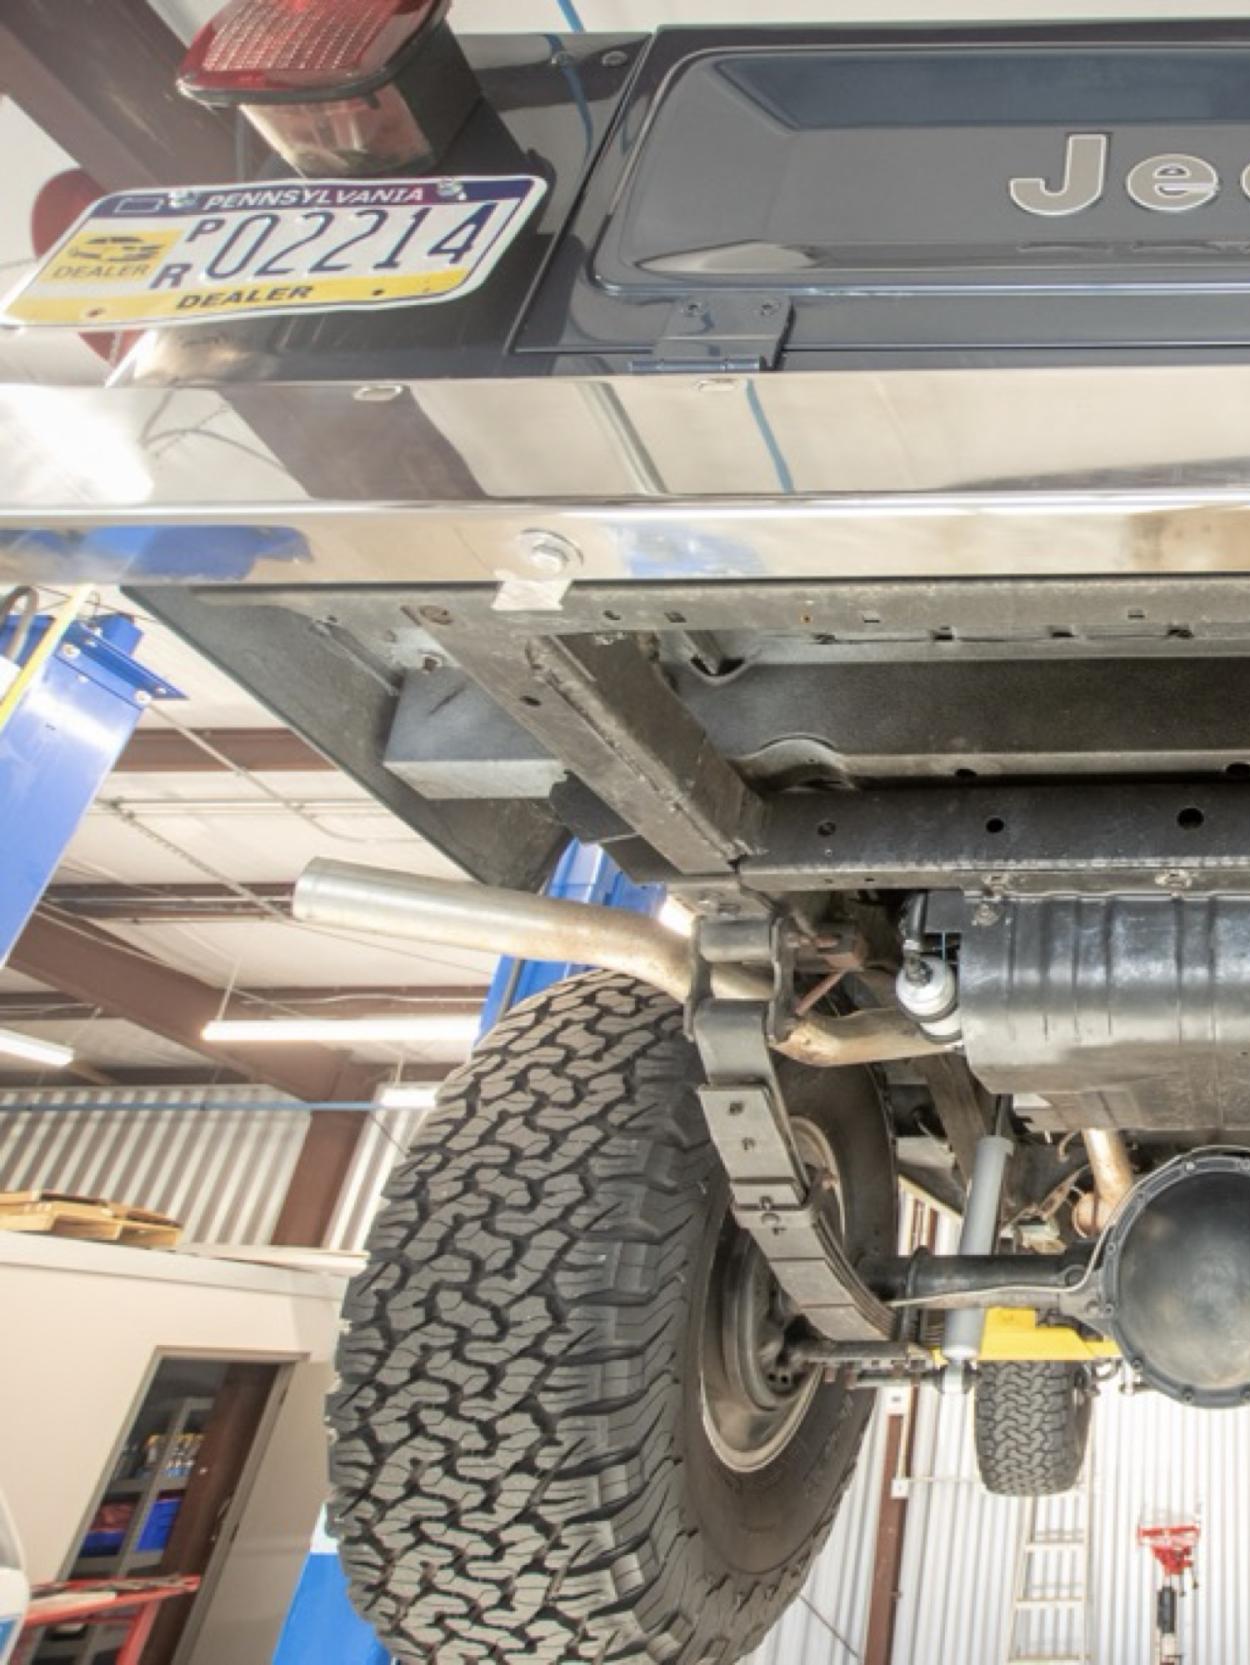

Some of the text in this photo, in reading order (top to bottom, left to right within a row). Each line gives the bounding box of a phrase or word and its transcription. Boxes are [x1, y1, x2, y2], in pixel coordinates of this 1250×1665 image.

[203, 187, 423, 211] PENNSYLVANIA
[52, 264, 150, 279] DEALER
[176, 285, 314, 310] DEALER
